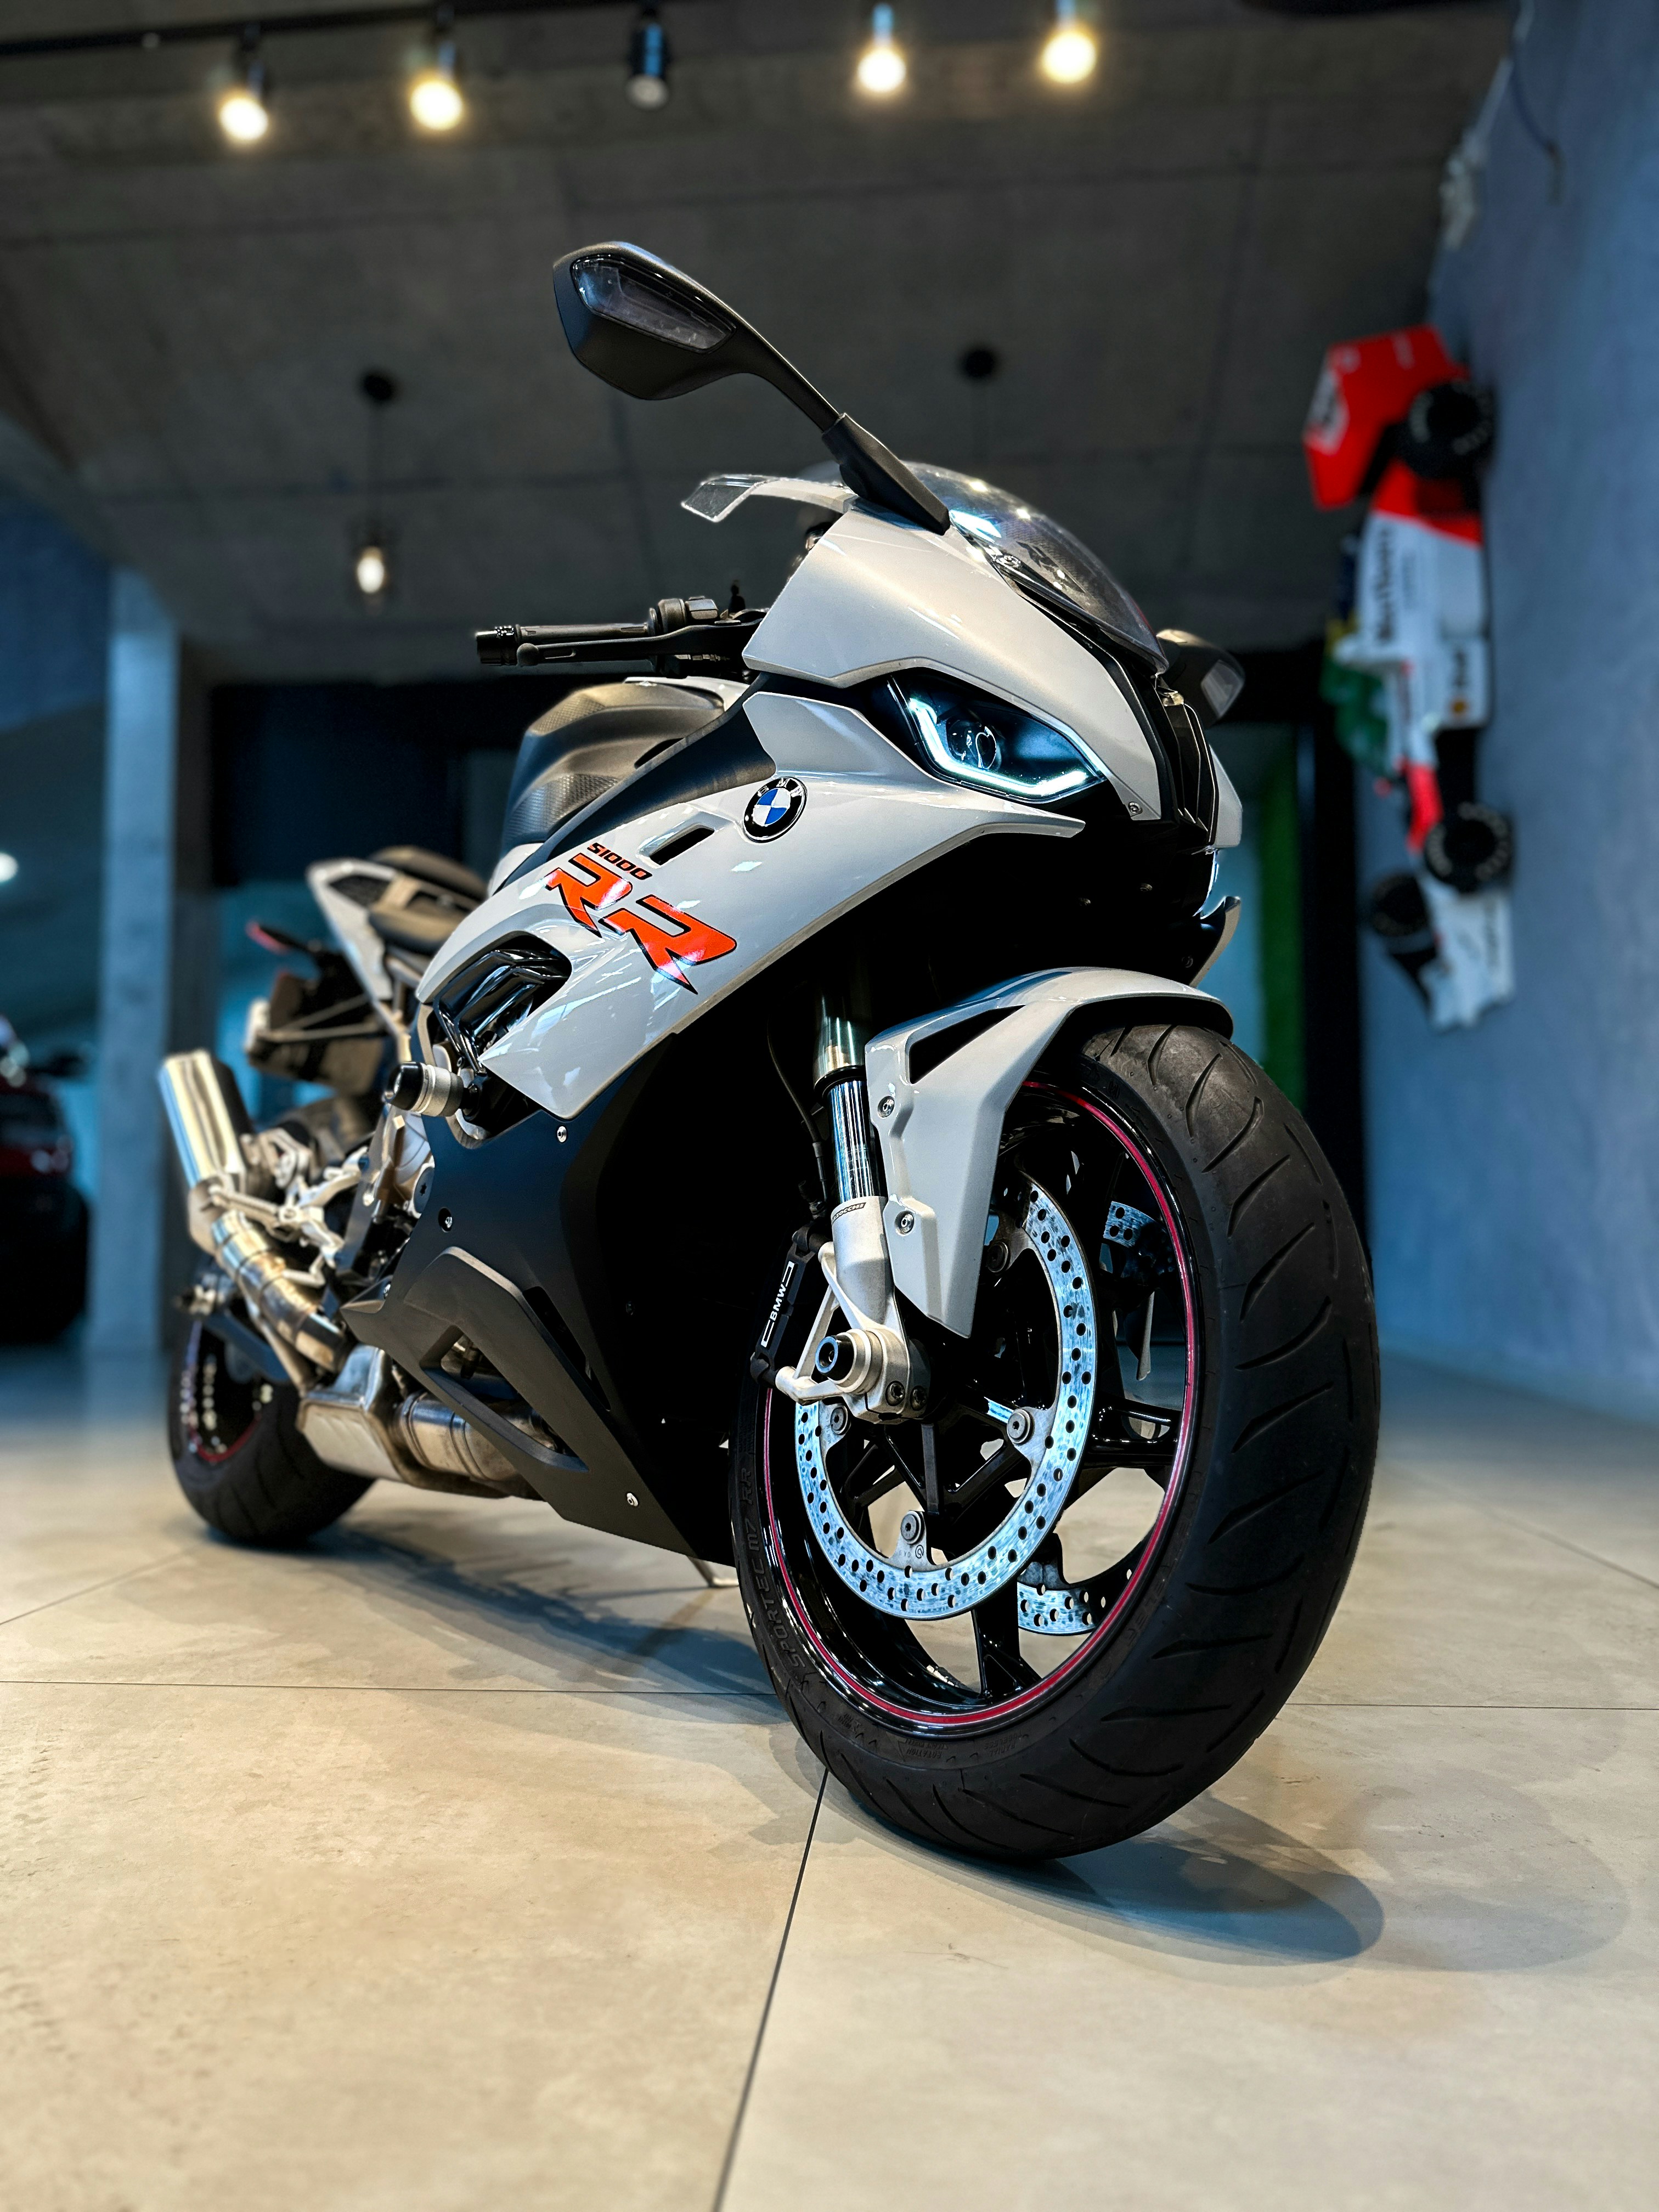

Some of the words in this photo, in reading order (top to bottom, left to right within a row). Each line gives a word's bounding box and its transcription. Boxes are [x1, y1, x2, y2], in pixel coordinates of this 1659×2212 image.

[757, 777, 803, 798] BMW
[586, 842, 653, 880] S1000
[544, 852, 737, 995] RR
[769, 1283, 786, 1321] BMW
[741, 1467, 753, 1505] RR
[752, 1558, 806, 1668] SPORTEC
